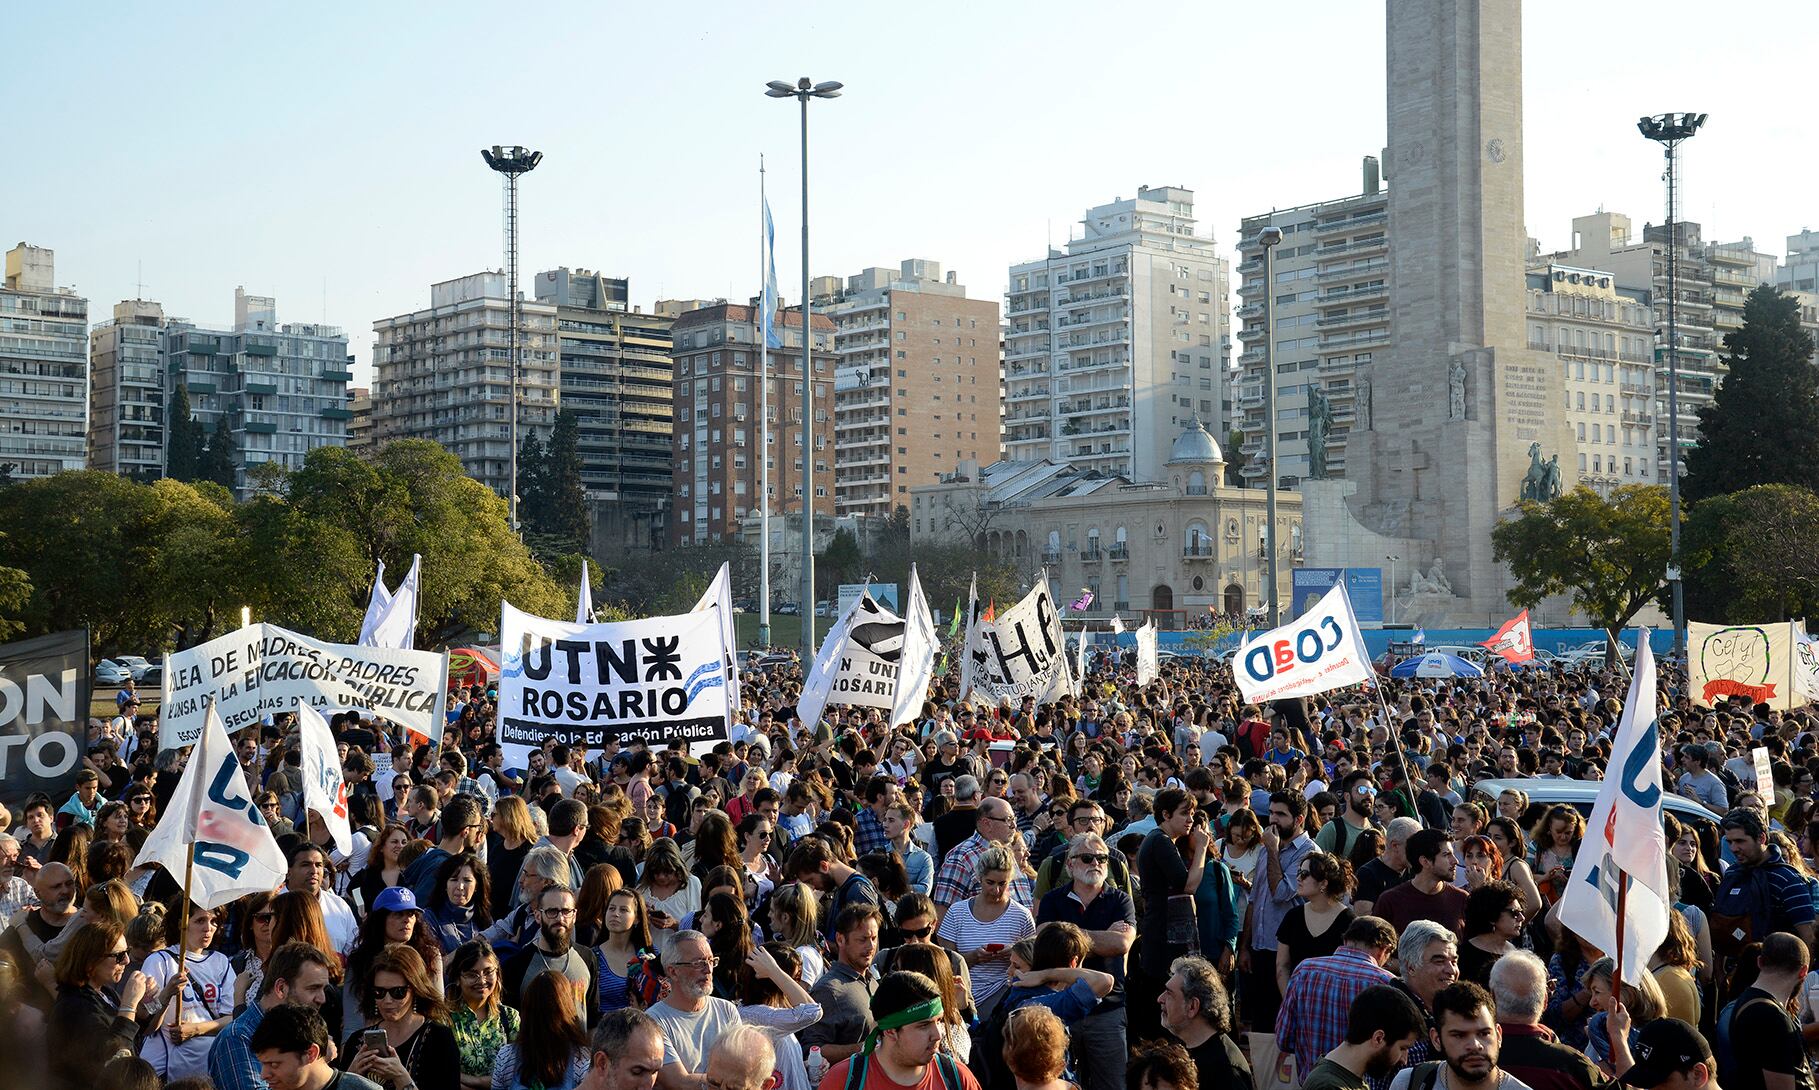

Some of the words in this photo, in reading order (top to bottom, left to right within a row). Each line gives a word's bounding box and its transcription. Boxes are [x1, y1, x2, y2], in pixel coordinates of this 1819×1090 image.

[169, 664, 202, 692] LEA
[211, 650, 238, 678] DE
[247, 637, 321, 665] MADRES
[336, 657, 419, 687] PADRES
[522, 632, 639, 685] UTN
[841, 658, 852, 671] N
[221, 683, 238, 702] LA
[996, 669, 1051, 696] ESTUDIANTE
[177, 726, 204, 742] ESCUE
[312, 695, 327, 706] LA
[338, 693, 376, 711] UNR
[522, 687, 688, 721] ROSARIO
[586, 727, 659, 744] Edcación
